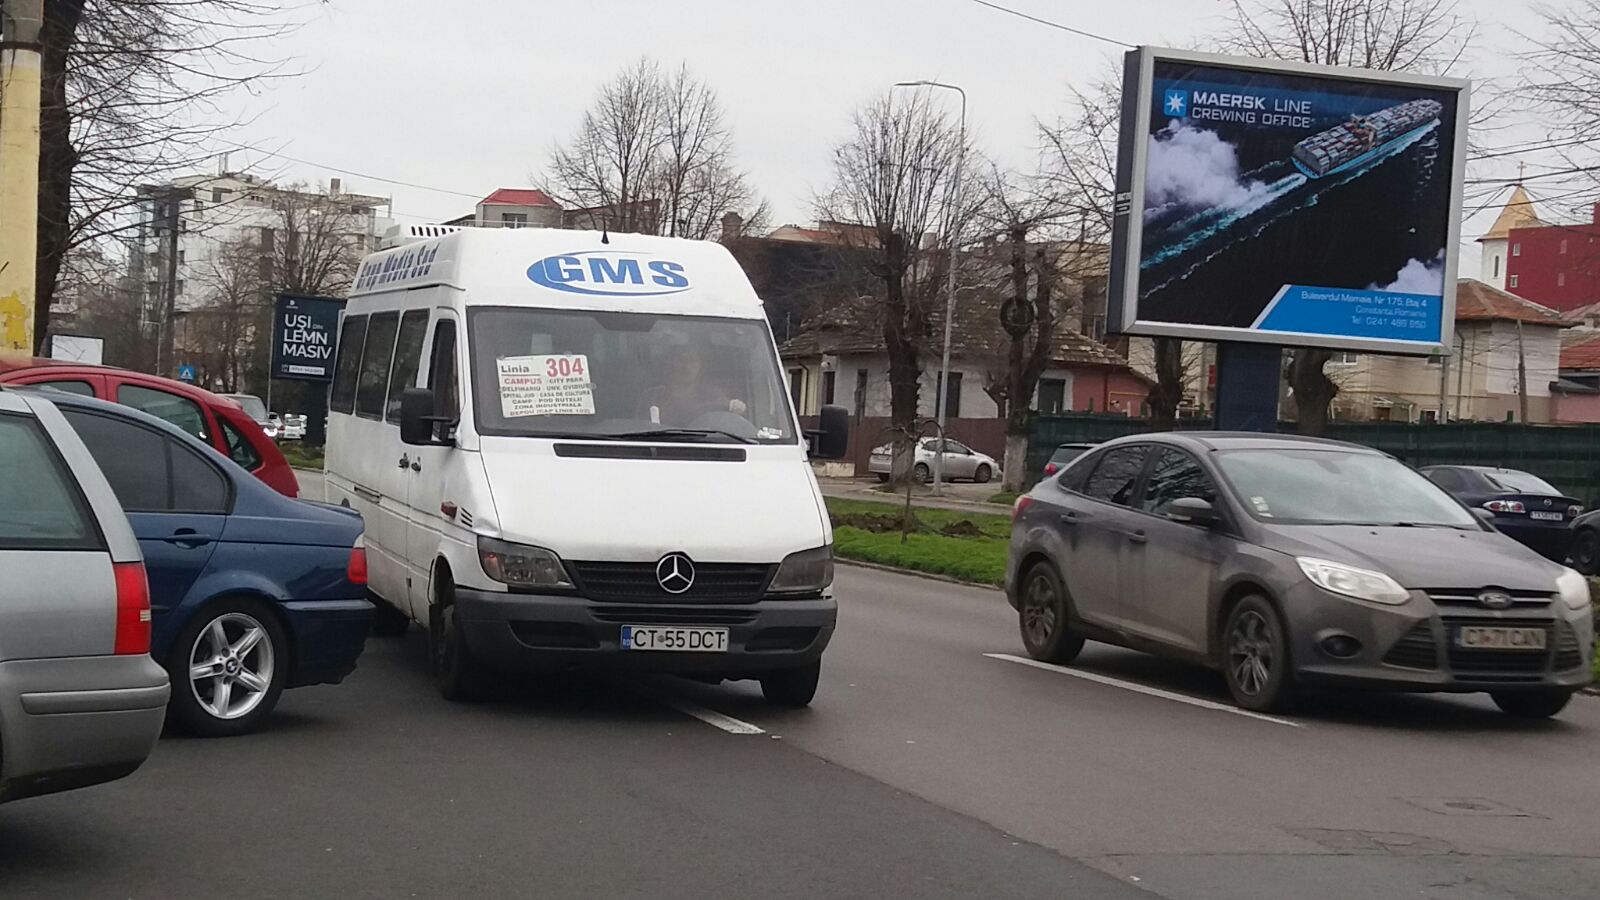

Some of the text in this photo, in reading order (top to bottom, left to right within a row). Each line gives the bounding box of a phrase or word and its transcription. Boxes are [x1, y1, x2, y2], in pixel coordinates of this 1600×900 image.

[1192, 91, 1312, 114] MAERSK LINE
[1191, 107, 1311, 128] CREWING OFFICE
[543, 256, 690, 288] GMS
[1420, 299, 1428, 307] 4
[283, 328, 328, 346] LEMN
[282, 342, 333, 360] MASIV
[500, 357, 584, 378] Linia 304
